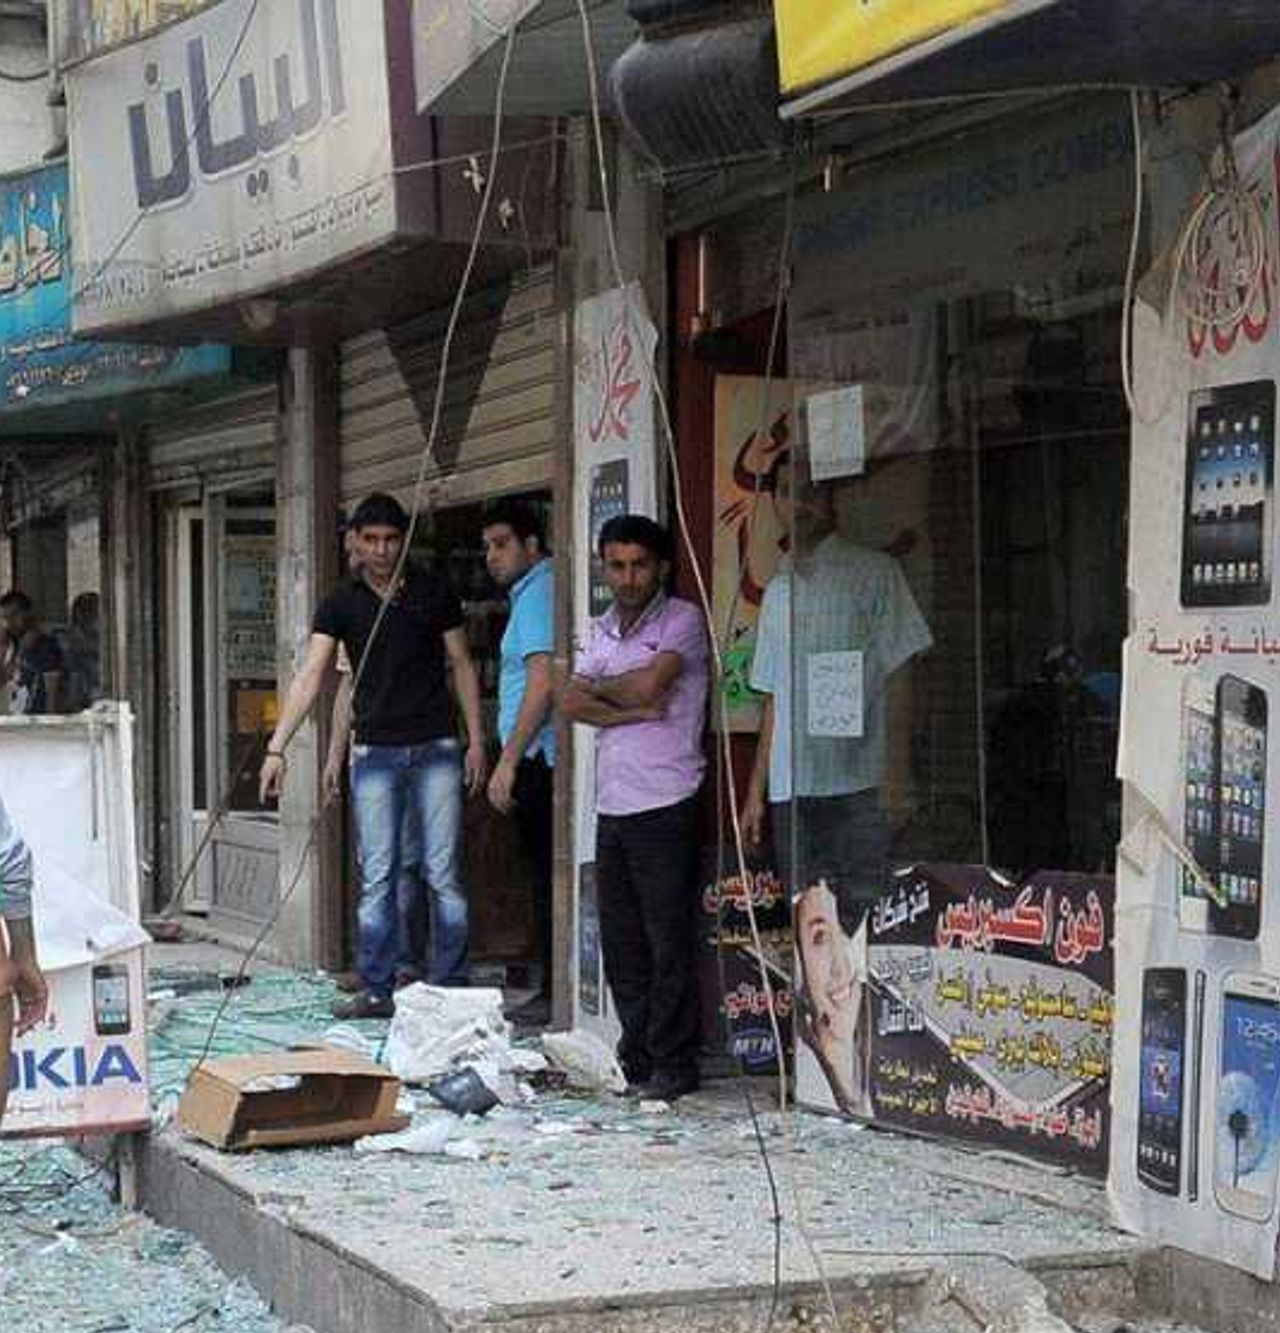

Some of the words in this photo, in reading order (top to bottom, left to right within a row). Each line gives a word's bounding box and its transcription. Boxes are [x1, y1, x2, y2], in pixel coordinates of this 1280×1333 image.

[126, 0, 347, 209] البيان
[1147, 626, 1213, 665] فورية
[1054, 890, 1106, 963] فون
[9, 1044, 143, 1090] KIA
[733, 1034, 776, 1057] MTN
